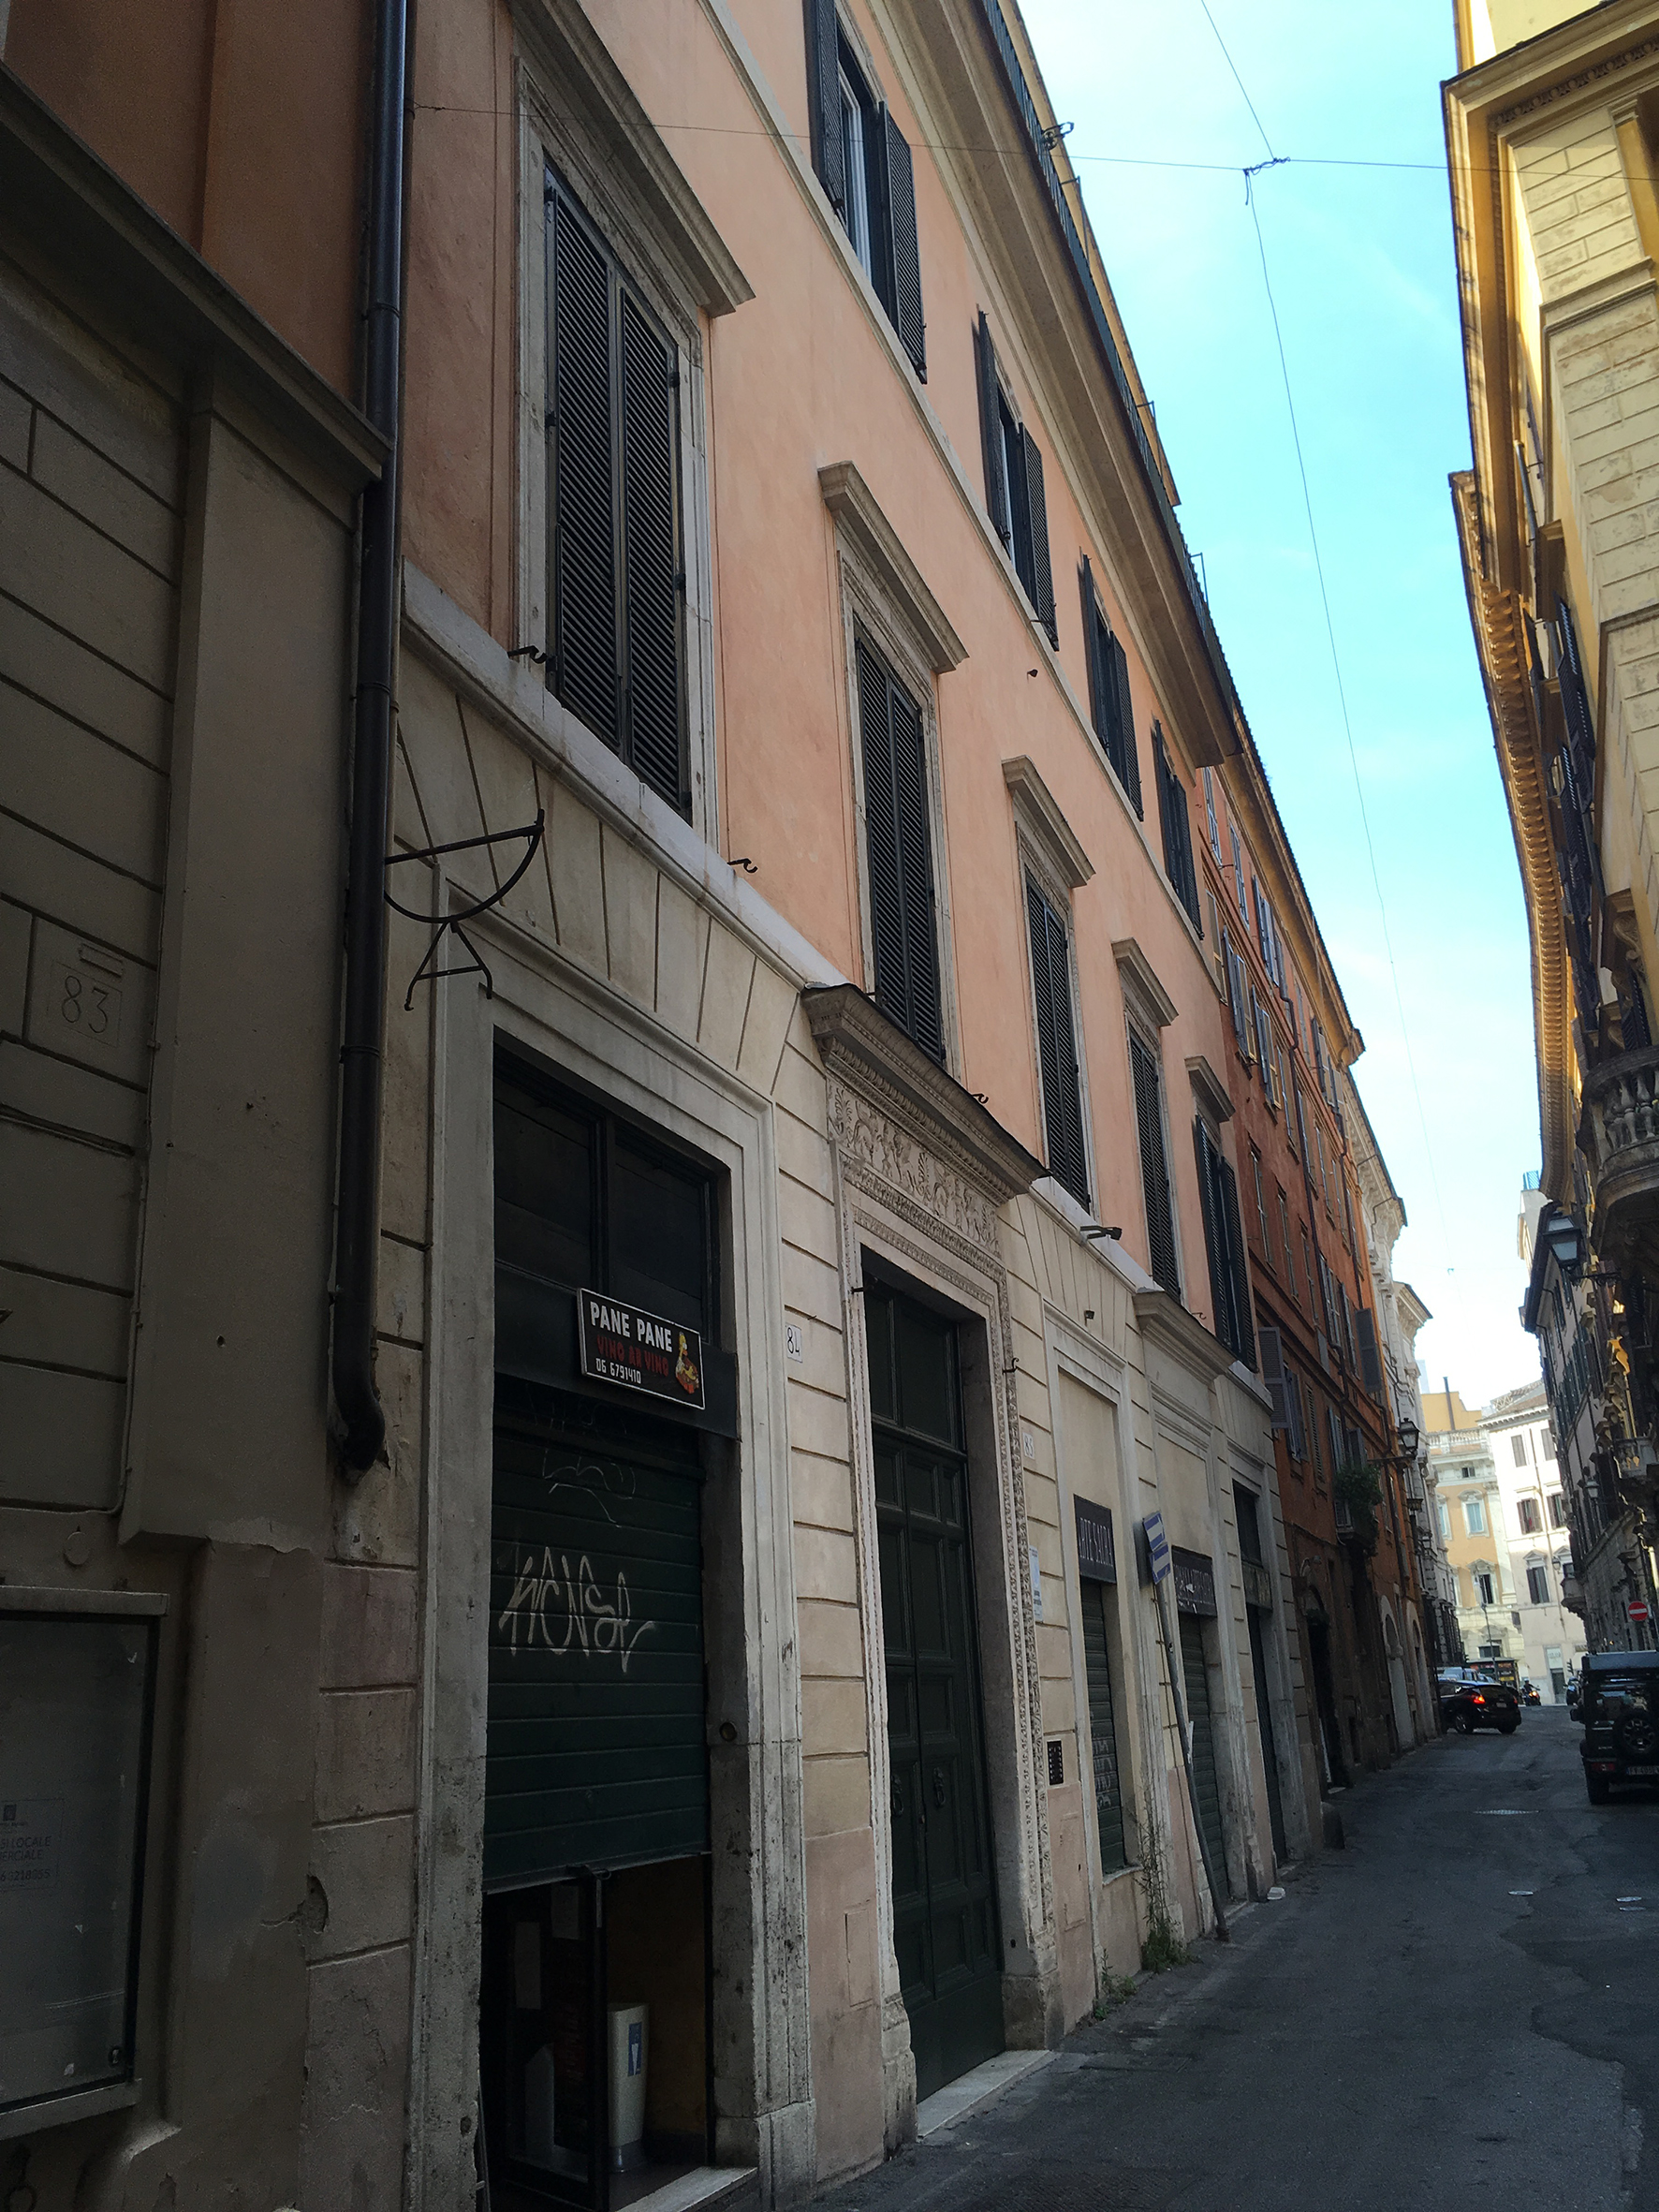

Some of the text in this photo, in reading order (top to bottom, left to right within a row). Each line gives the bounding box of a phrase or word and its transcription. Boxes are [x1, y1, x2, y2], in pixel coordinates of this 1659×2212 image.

[62, 975, 110, 1033] 83
[590, 1301, 672, 1353] PANE PANE
[786, 1327, 800, 1357] 84
[595, 1357, 641, 1384] 06 6791410
[596, 1334, 669, 1377] VINO AR VINO
